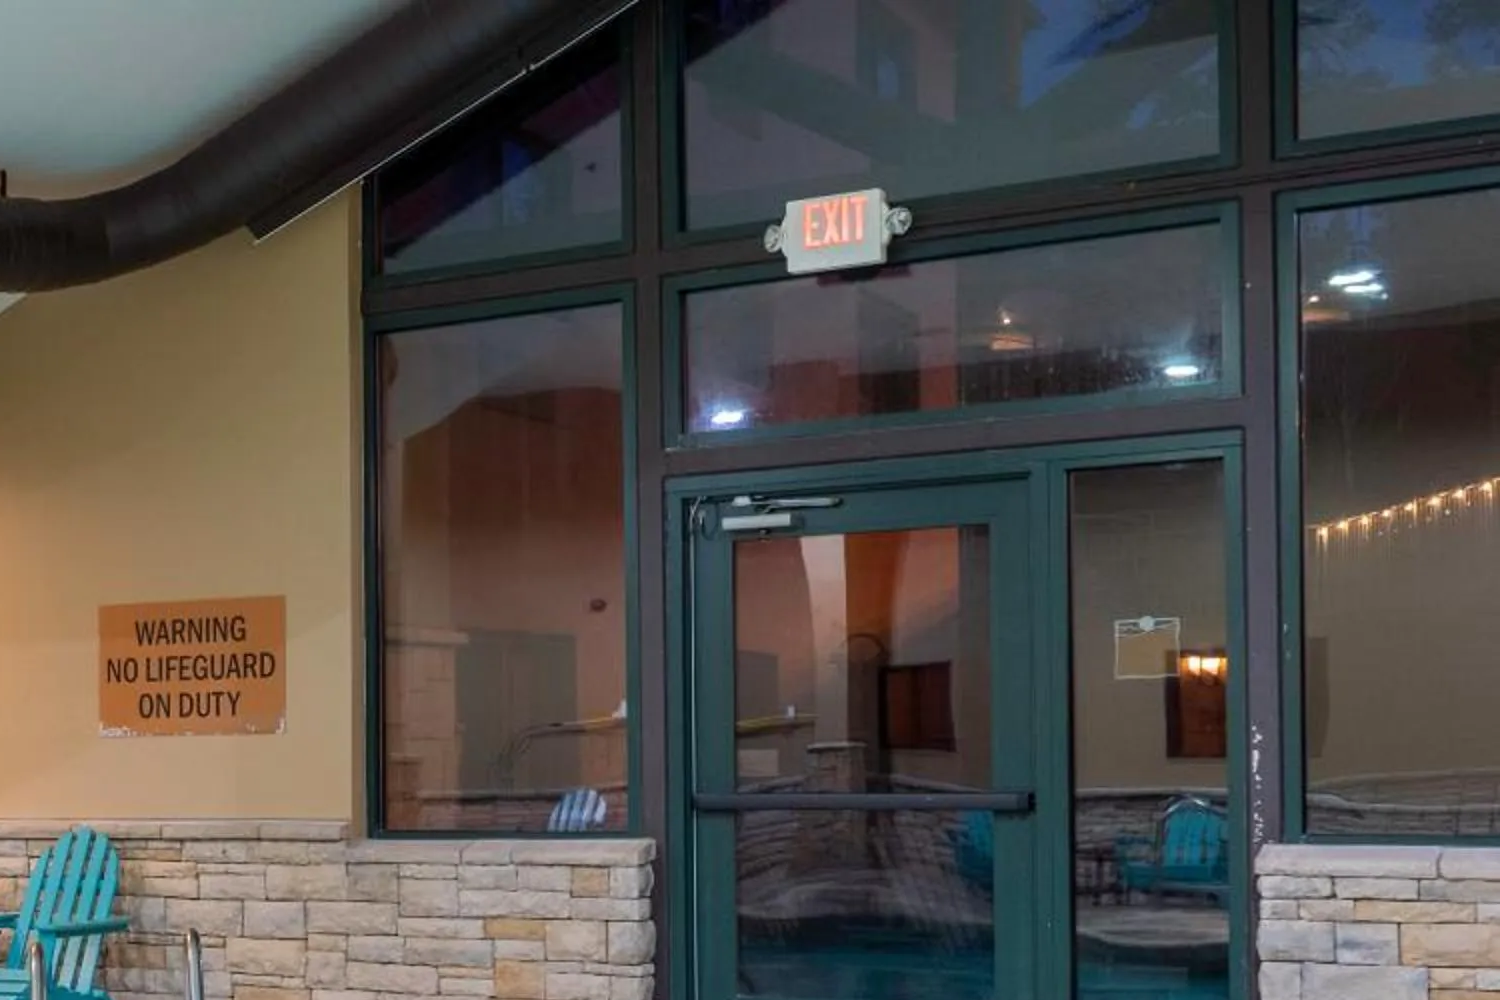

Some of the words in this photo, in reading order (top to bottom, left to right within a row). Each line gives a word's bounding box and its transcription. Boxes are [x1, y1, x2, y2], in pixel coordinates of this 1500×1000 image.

[803, 195, 869, 250] EXIT
[134, 614, 248, 647] WARNING
[107, 656, 139, 684] NO
[145, 651, 277, 683] LIFEGUARD
[138, 692, 171, 720] ON
[178, 690, 242, 719] DUTY
